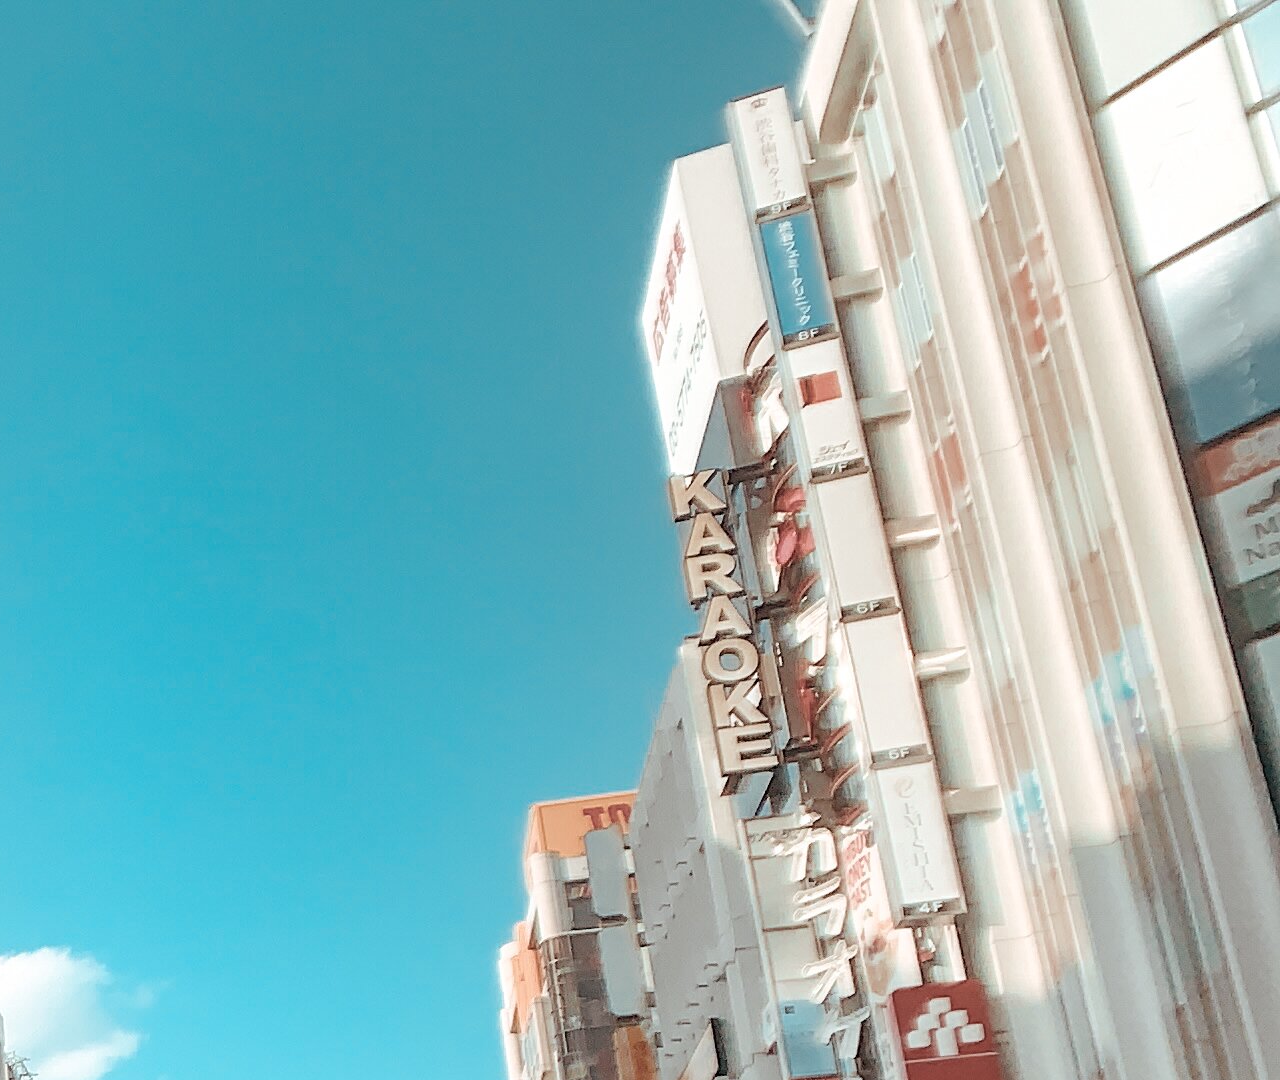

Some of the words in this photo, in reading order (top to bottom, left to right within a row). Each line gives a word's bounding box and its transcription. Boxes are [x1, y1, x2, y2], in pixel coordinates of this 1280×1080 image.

[798, 328, 819, 341] 8F
[855, 601, 879, 613] 6F
[670, 469, 779, 776] KARAOKE
[919, 901, 944, 913] 4F
